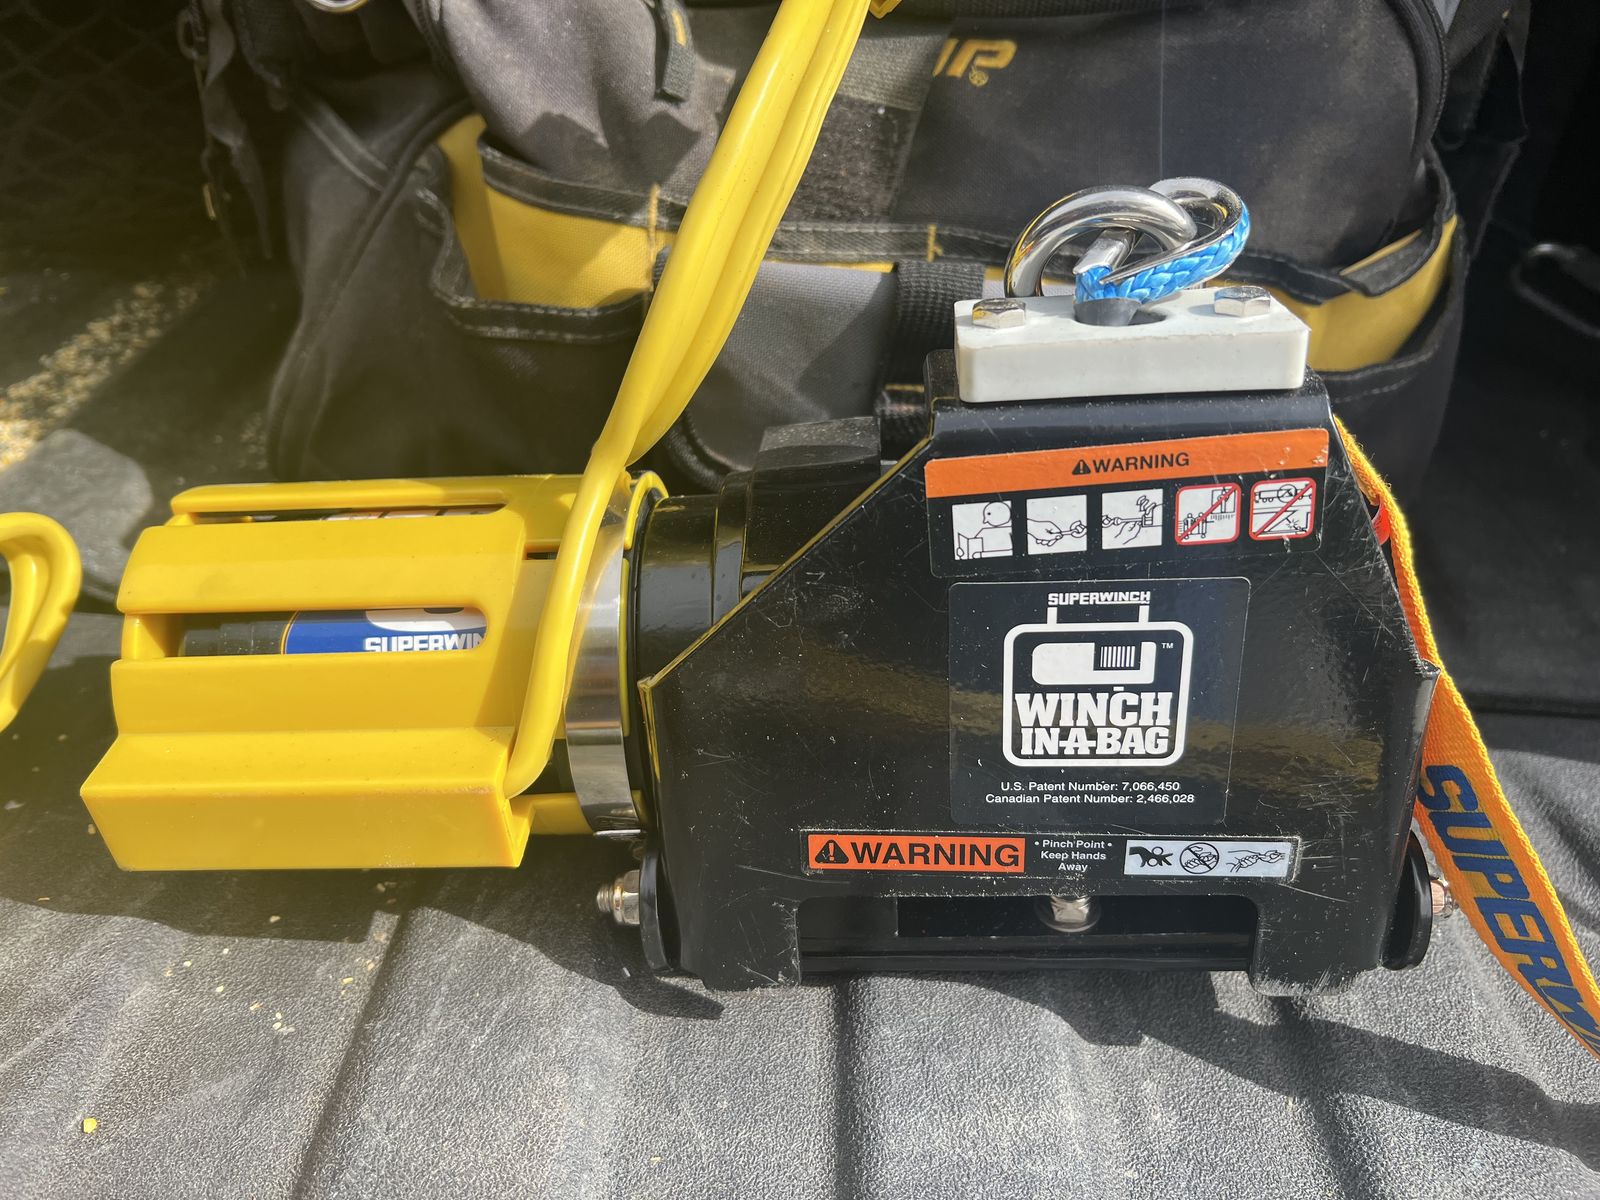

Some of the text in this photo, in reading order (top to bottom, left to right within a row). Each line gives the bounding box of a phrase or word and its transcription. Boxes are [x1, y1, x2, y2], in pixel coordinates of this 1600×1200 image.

[1092, 452, 1190, 474] WARNING
[1048, 591, 1151, 606] SUPERWINCH
[1014, 691, 1173, 727] WINCH
[1020, 727, 1169, 755] IN-A-BAG
[1000, 781, 1180, 794] U.S. Patent Number: 7,066,450
[985, 793, 1195, 805] Canadian Patent Number: 2,466,028
[1042, 839, 1105, 849] Pinch Point
[849, 840, 1020, 868] WARNING
[1040, 850, 1107, 861] Keep Hands
[1058, 862, 1088, 873] Away
